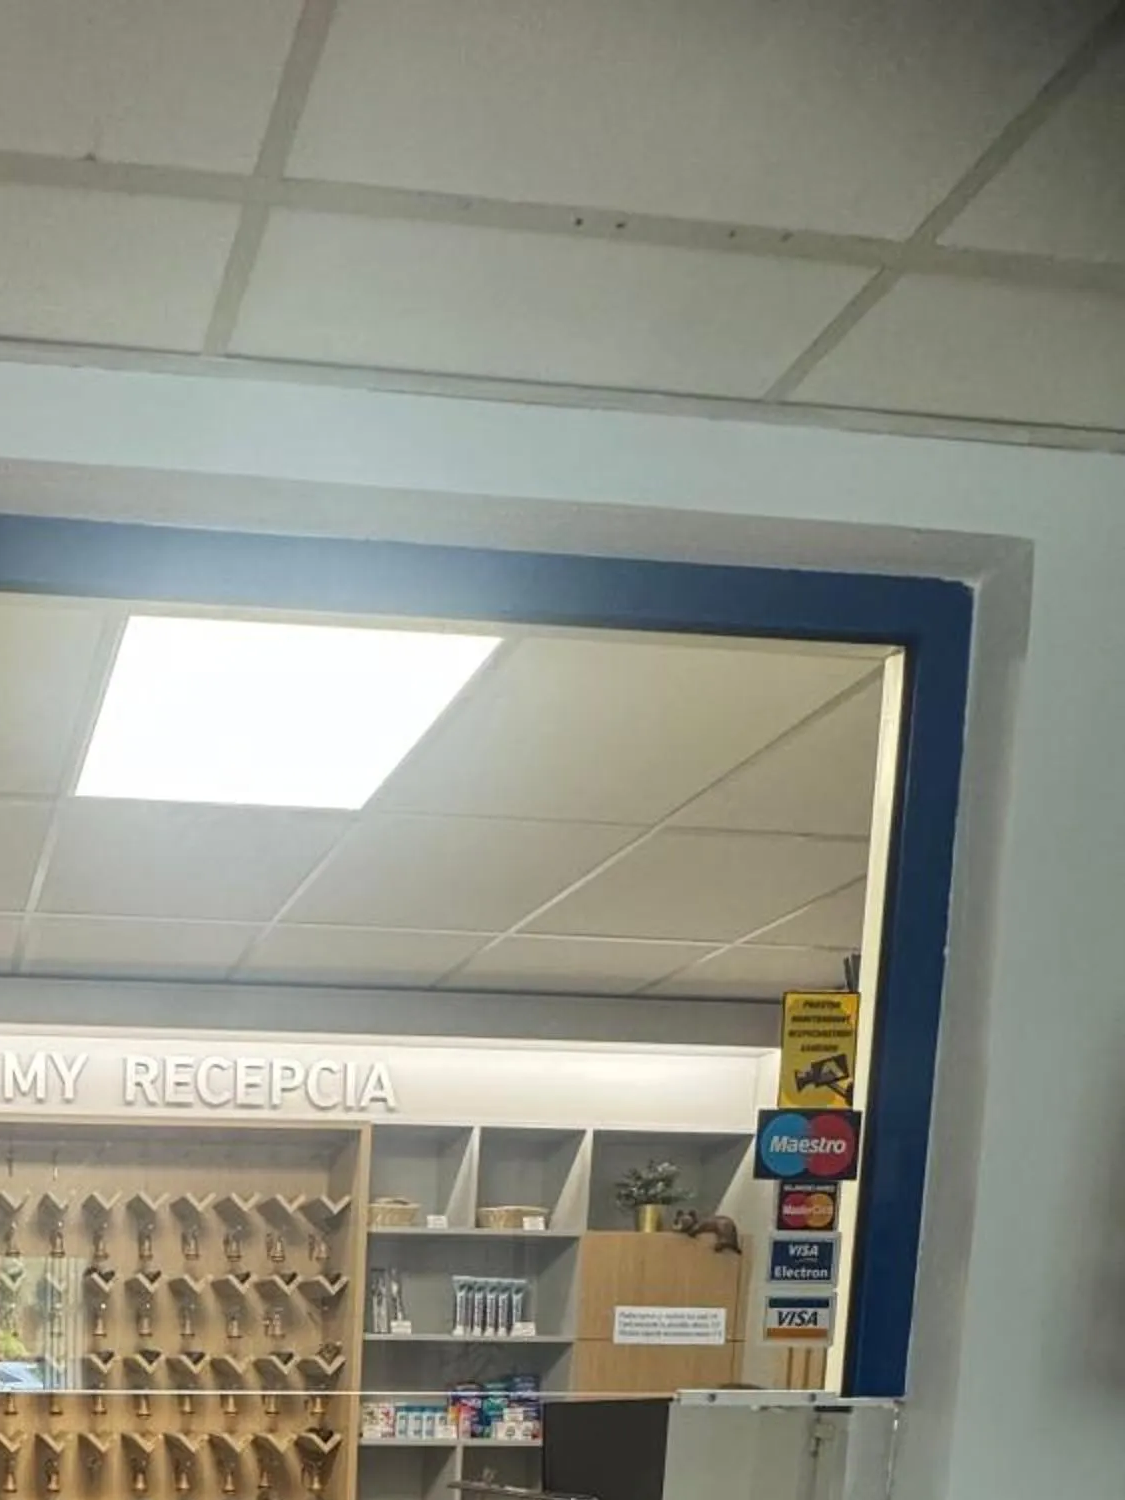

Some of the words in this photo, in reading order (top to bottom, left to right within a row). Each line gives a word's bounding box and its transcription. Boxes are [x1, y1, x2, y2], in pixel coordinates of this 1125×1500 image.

[123, 1055, 397, 1111] RECEPCIA
[769, 1135, 848, 1154] Maestro
[788, 1244, 819, 1257] VISA
[774, 1265, 829, 1278] Electron
[777, 1310, 819, 1327] VISA
